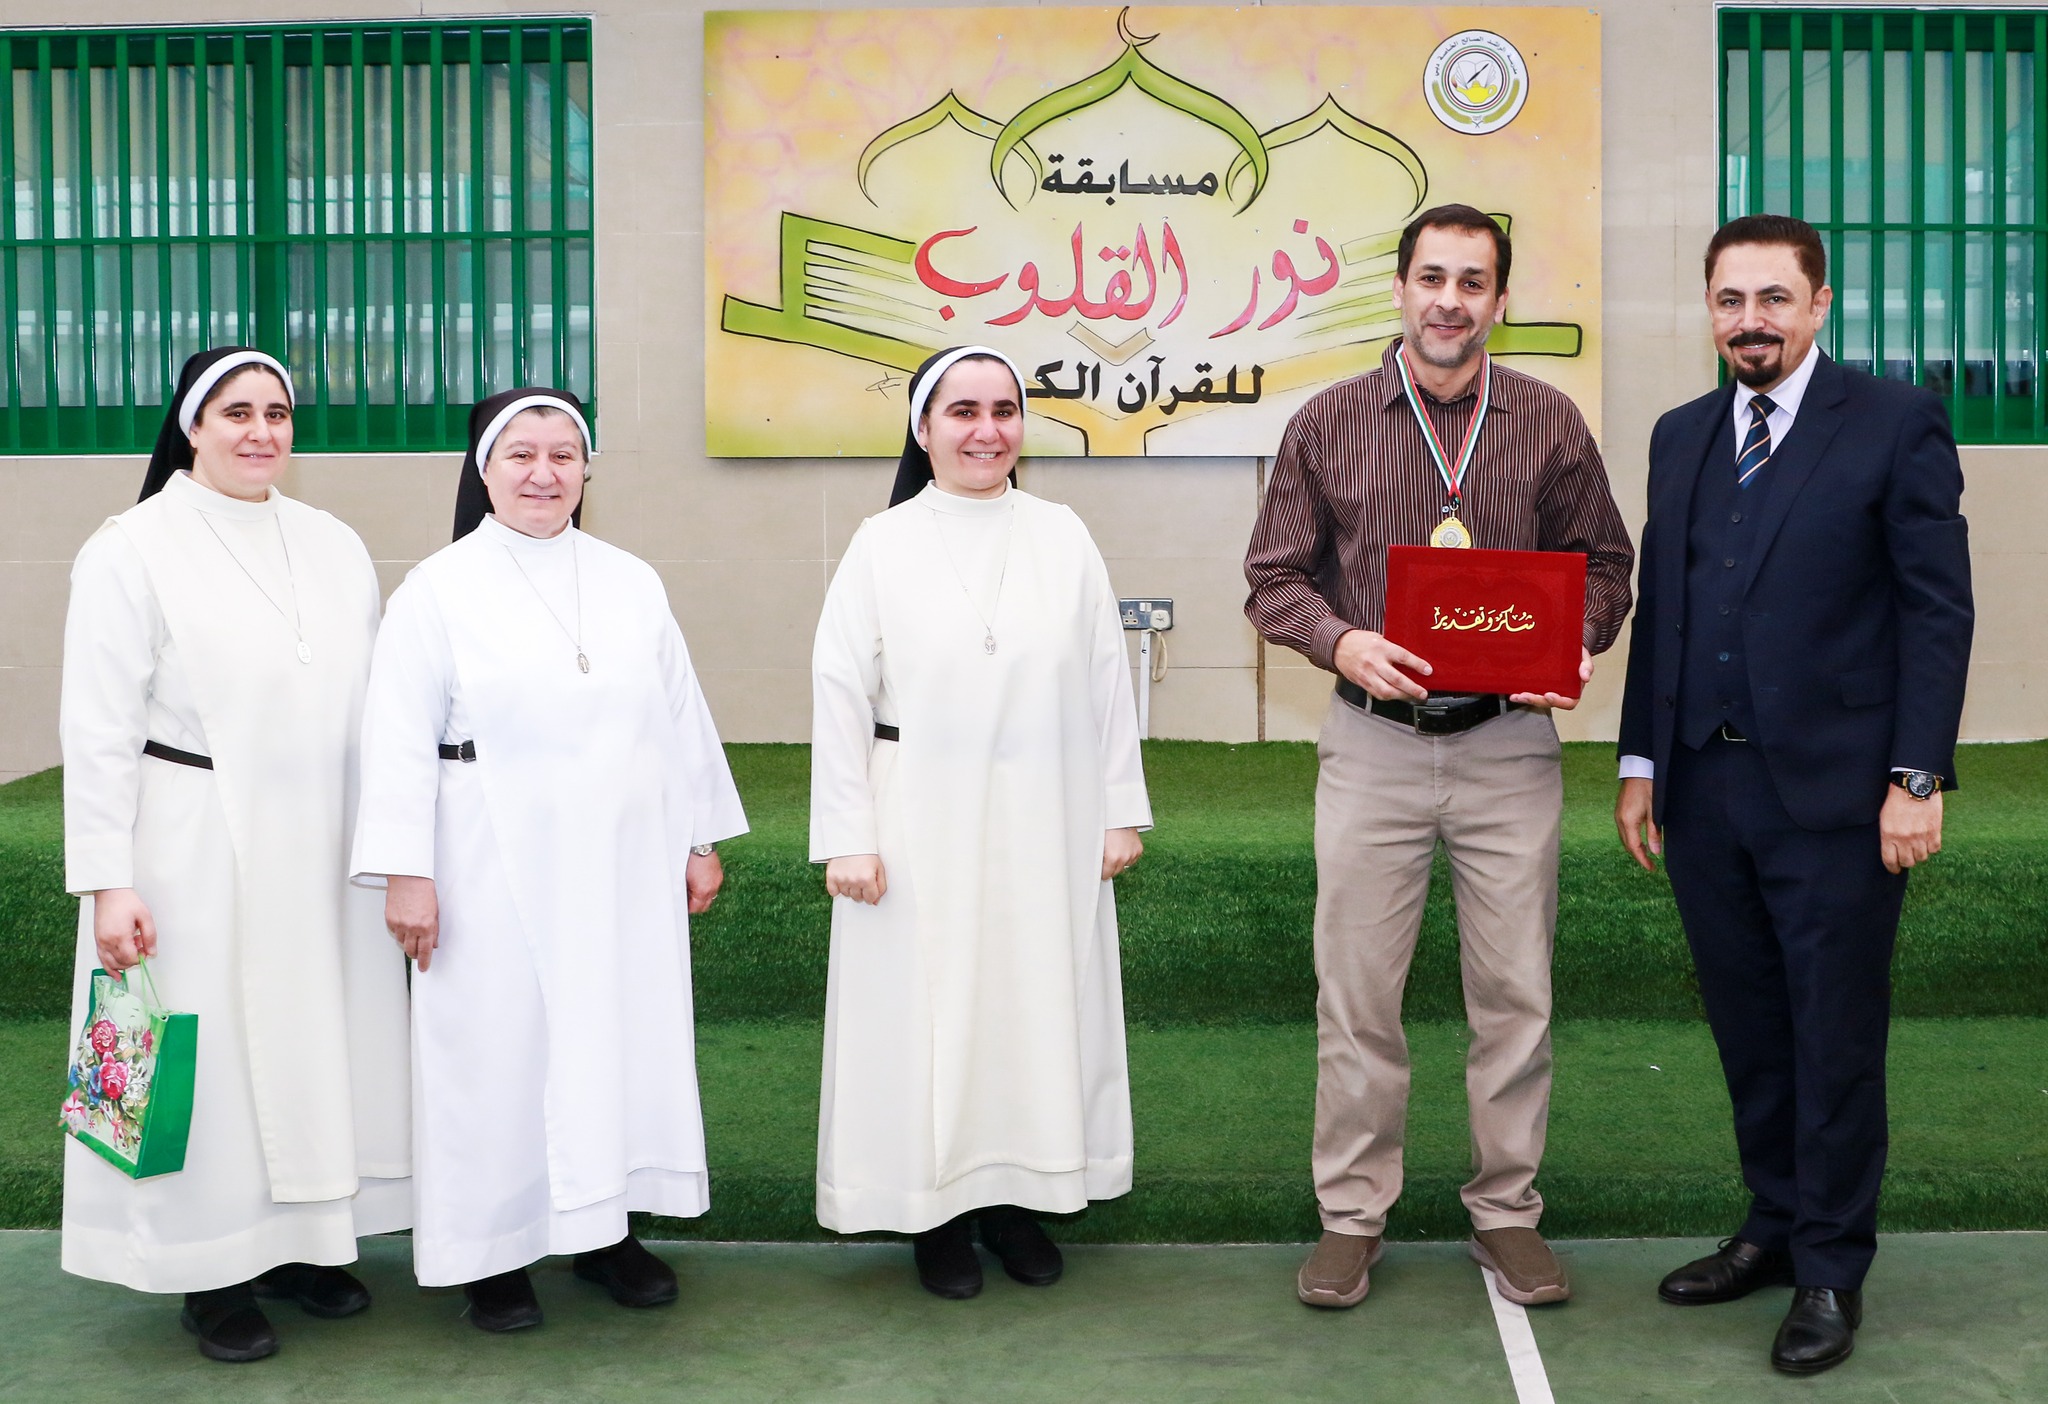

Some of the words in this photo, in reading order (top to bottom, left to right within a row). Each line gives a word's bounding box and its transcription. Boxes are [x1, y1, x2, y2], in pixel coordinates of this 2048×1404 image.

[1461, 36, 1483, 45] الصالح
[1507, 54, 1517, 74] مدرسة
[1040, 153, 1220, 206] مسابقة
[914, 221, 1188, 330] القلوب
[1208, 218, 1341, 339] نور
[1026, 360, 1101, 401] الك
[1117, 355, 1265, 415] للقرآن
